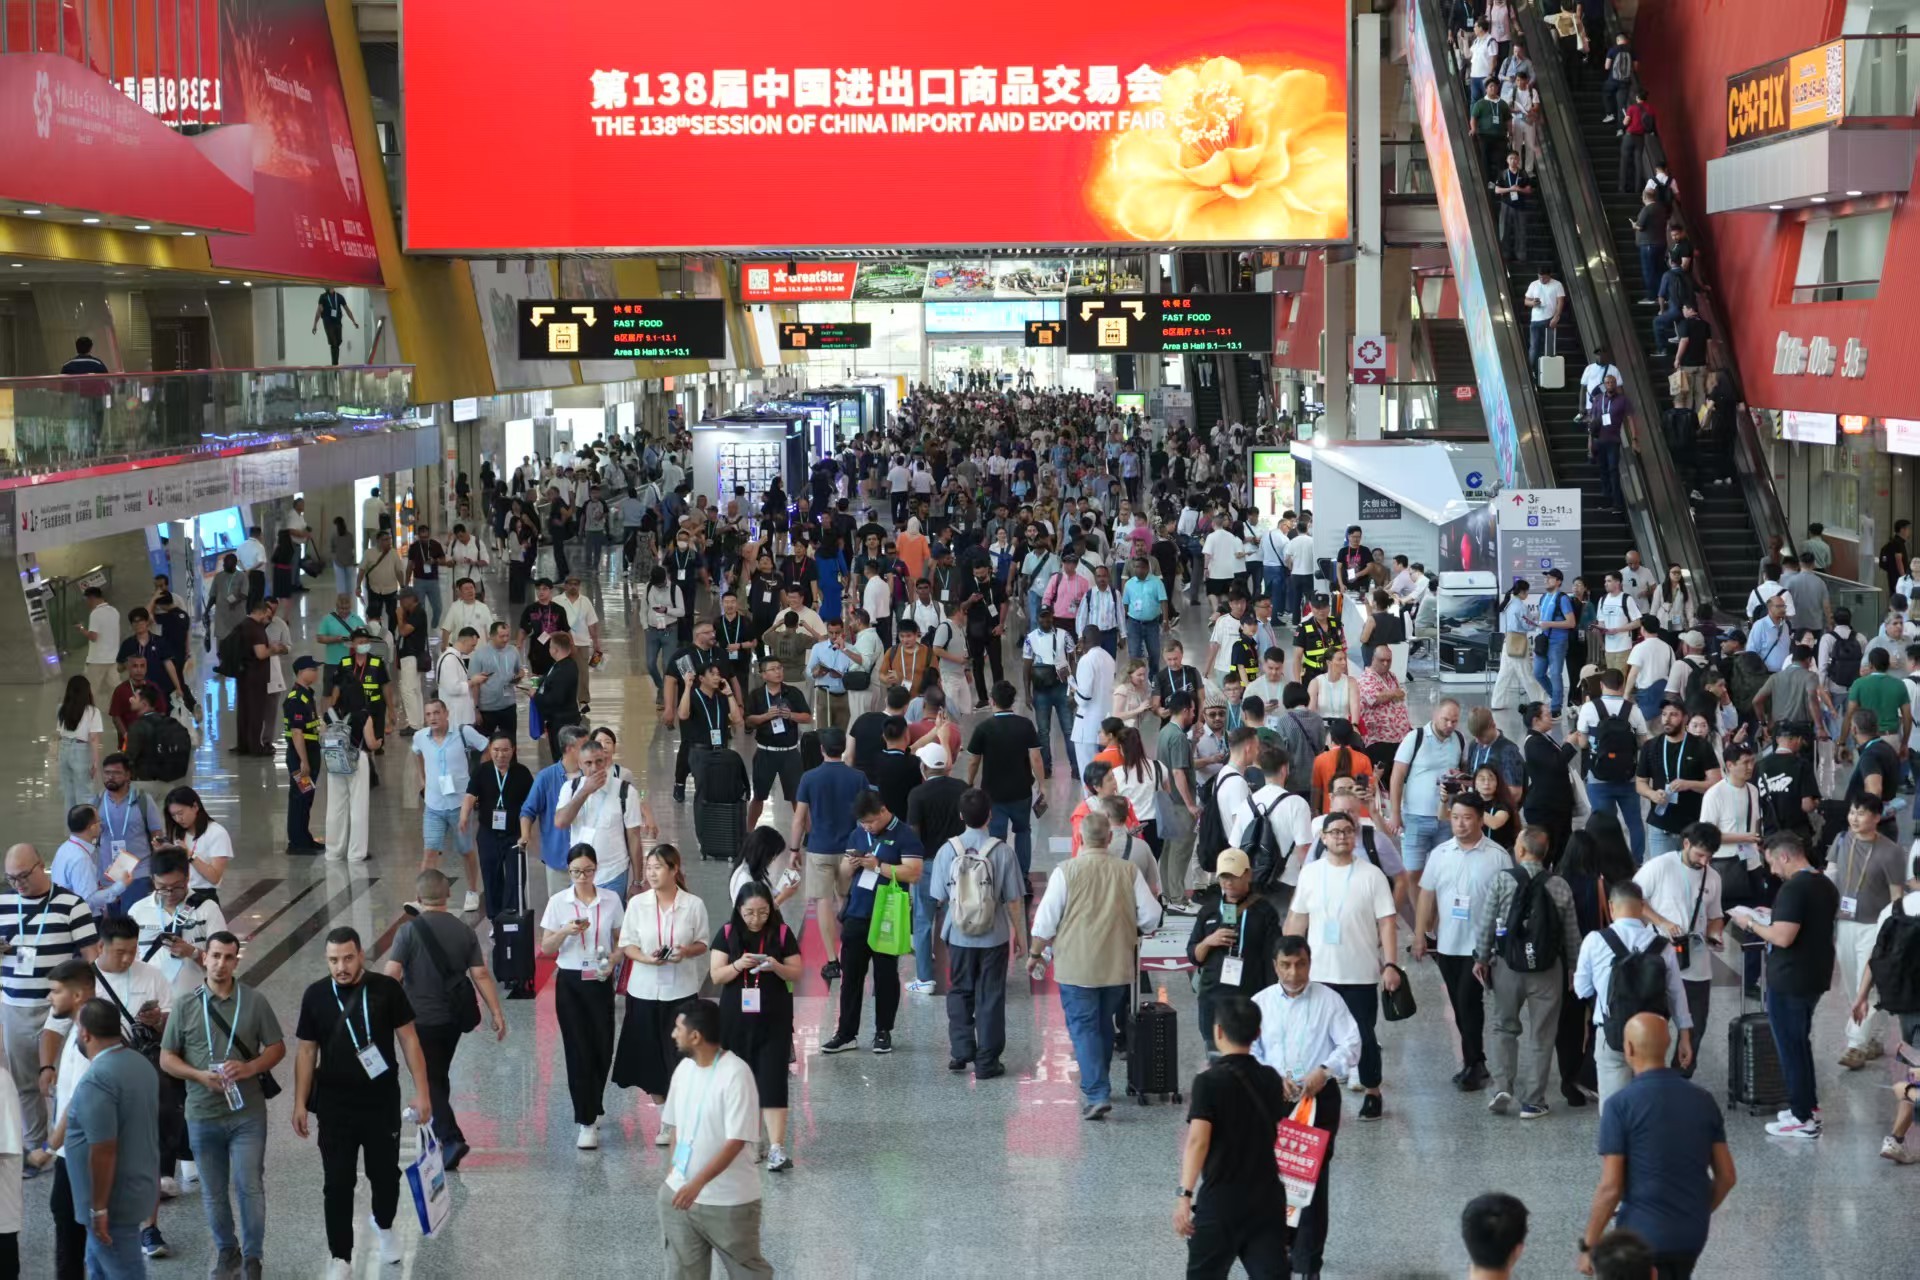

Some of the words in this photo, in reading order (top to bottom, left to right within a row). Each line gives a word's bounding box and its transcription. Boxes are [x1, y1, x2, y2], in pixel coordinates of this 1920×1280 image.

[590, 64, 1166, 109] 第138届中国进出口商品交易会
[591, 116, 635, 136] THE
[787, 114, 816, 135] OF
[819, 113, 888, 134] CHINA
[892, 112, 975, 133] IMPORT
[978, 112, 1025, 132] AND
[1029, 111, 1114, 131] EXPORT
[1118, 111, 1166, 130] FAIR
[614, 305, 643, 314] 快餐区
[1162, 342, 1181, 350] Area
[1182, 342, 1189, 350] B
[1190, 342, 1206, 350] Hall
[1528, 494, 1539, 503] 3F
[1525, 942, 1536, 969] adidas
